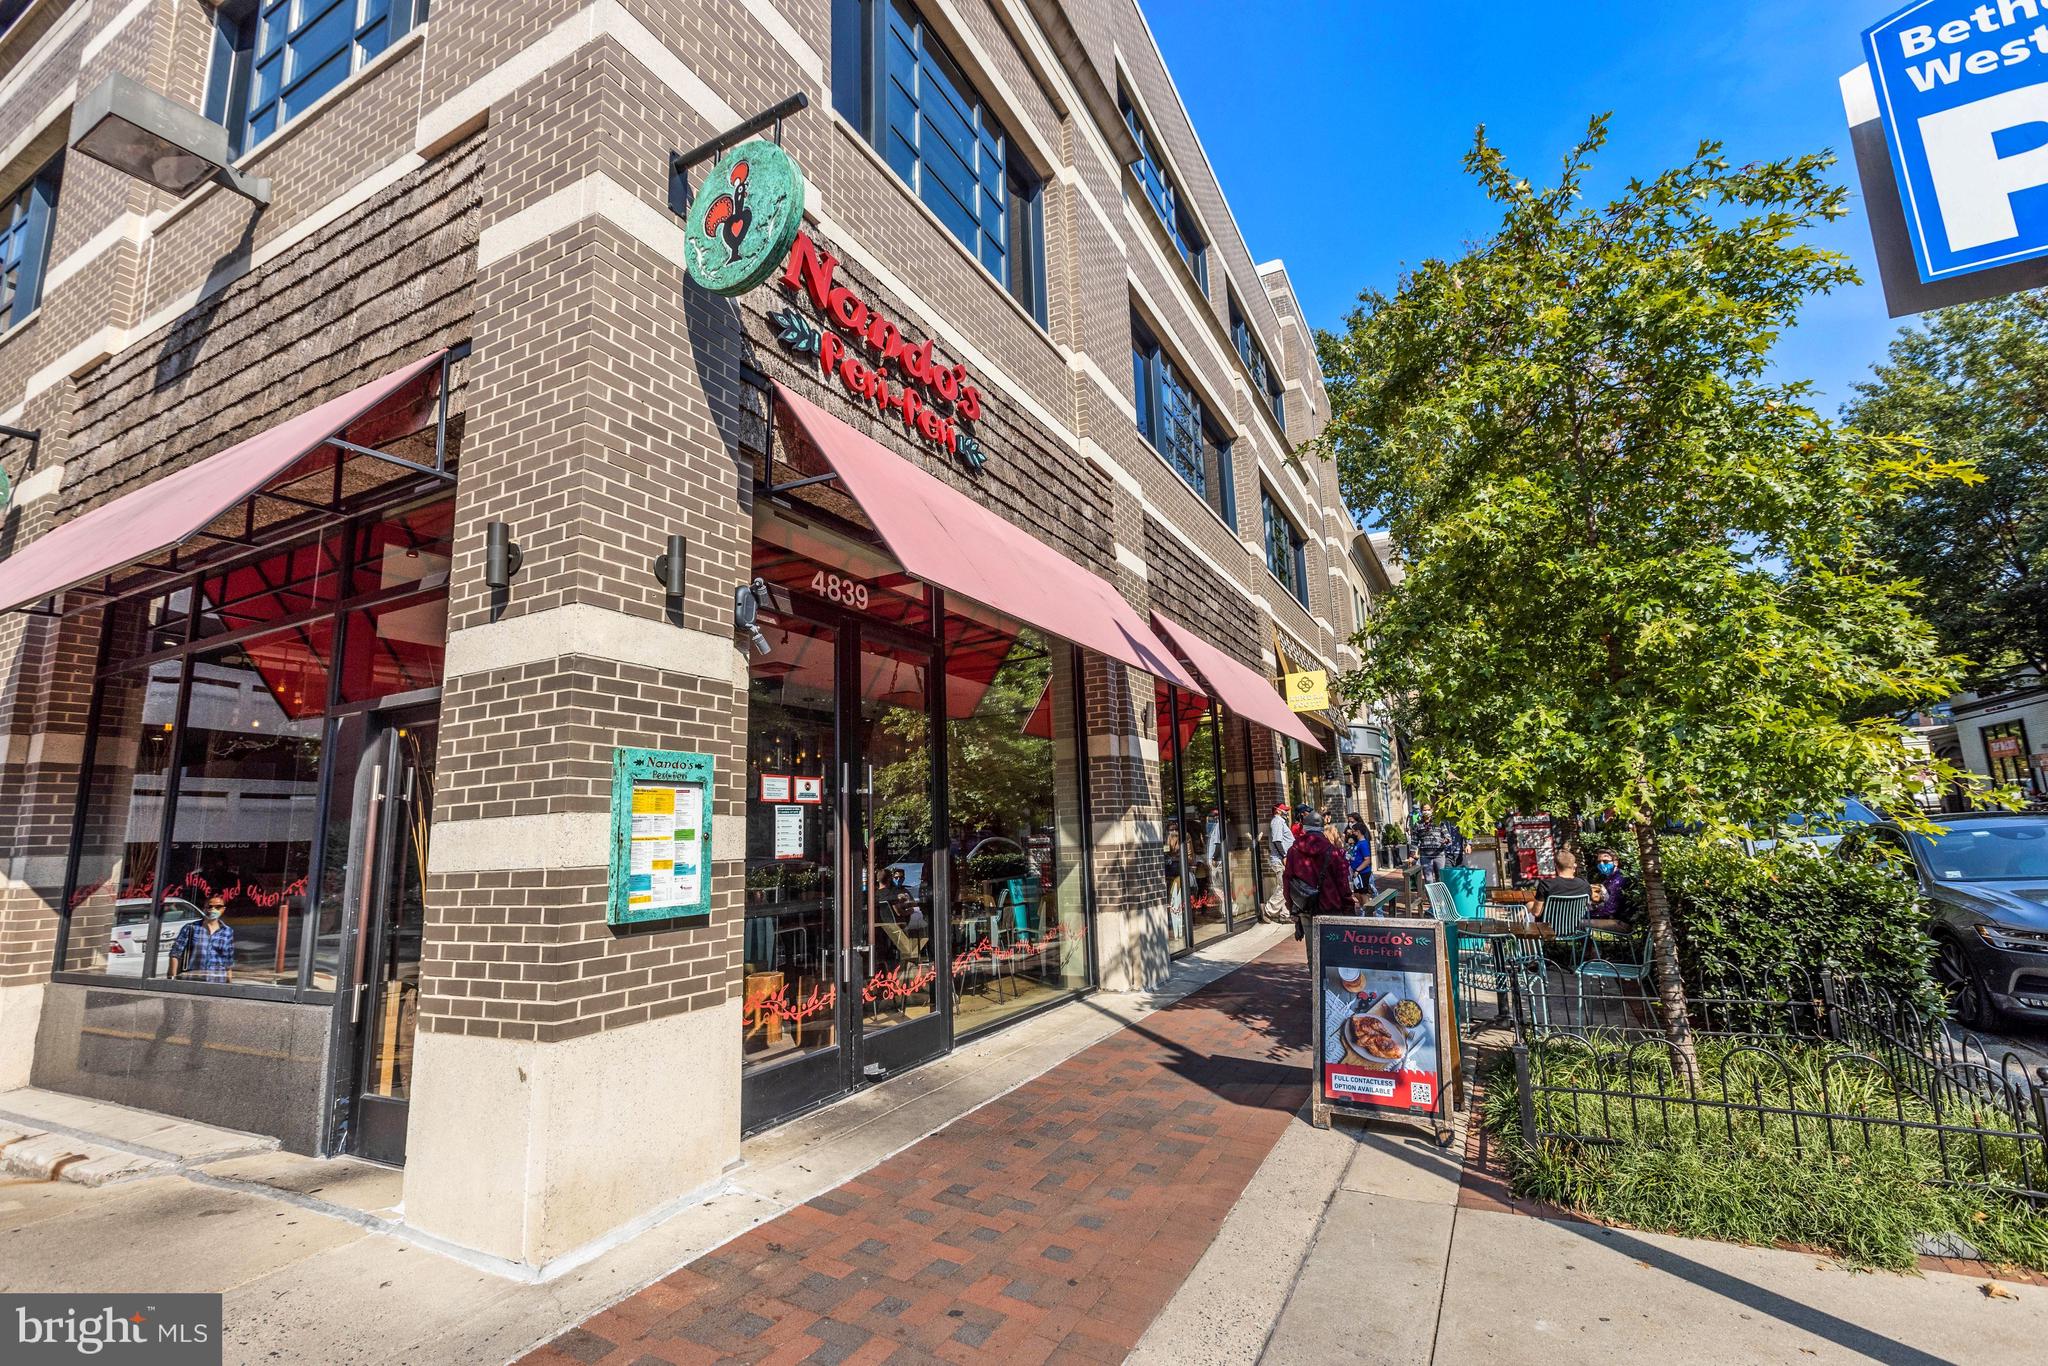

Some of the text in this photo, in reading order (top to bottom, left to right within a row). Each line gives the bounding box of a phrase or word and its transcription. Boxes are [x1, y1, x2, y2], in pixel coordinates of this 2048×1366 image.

[1917, 81, 2048, 253] P
[778, 230, 982, 421] Nando's
[820, 330, 957, 454] Peri-Peri
[811, 570, 869, 610] 4839
[647, 757, 694, 770] Nando's
[185, 872, 212, 898] flame
[247, 884, 280, 907] chicken
[1342, 929, 1414, 946] Nando's
[1353, 945, 1403, 958] Peri-Peri
[1334, 1075, 1393, 1087] FULL CONTACTLESS
[1334, 1083, 1391, 1095] OPTION AVAILABLE
